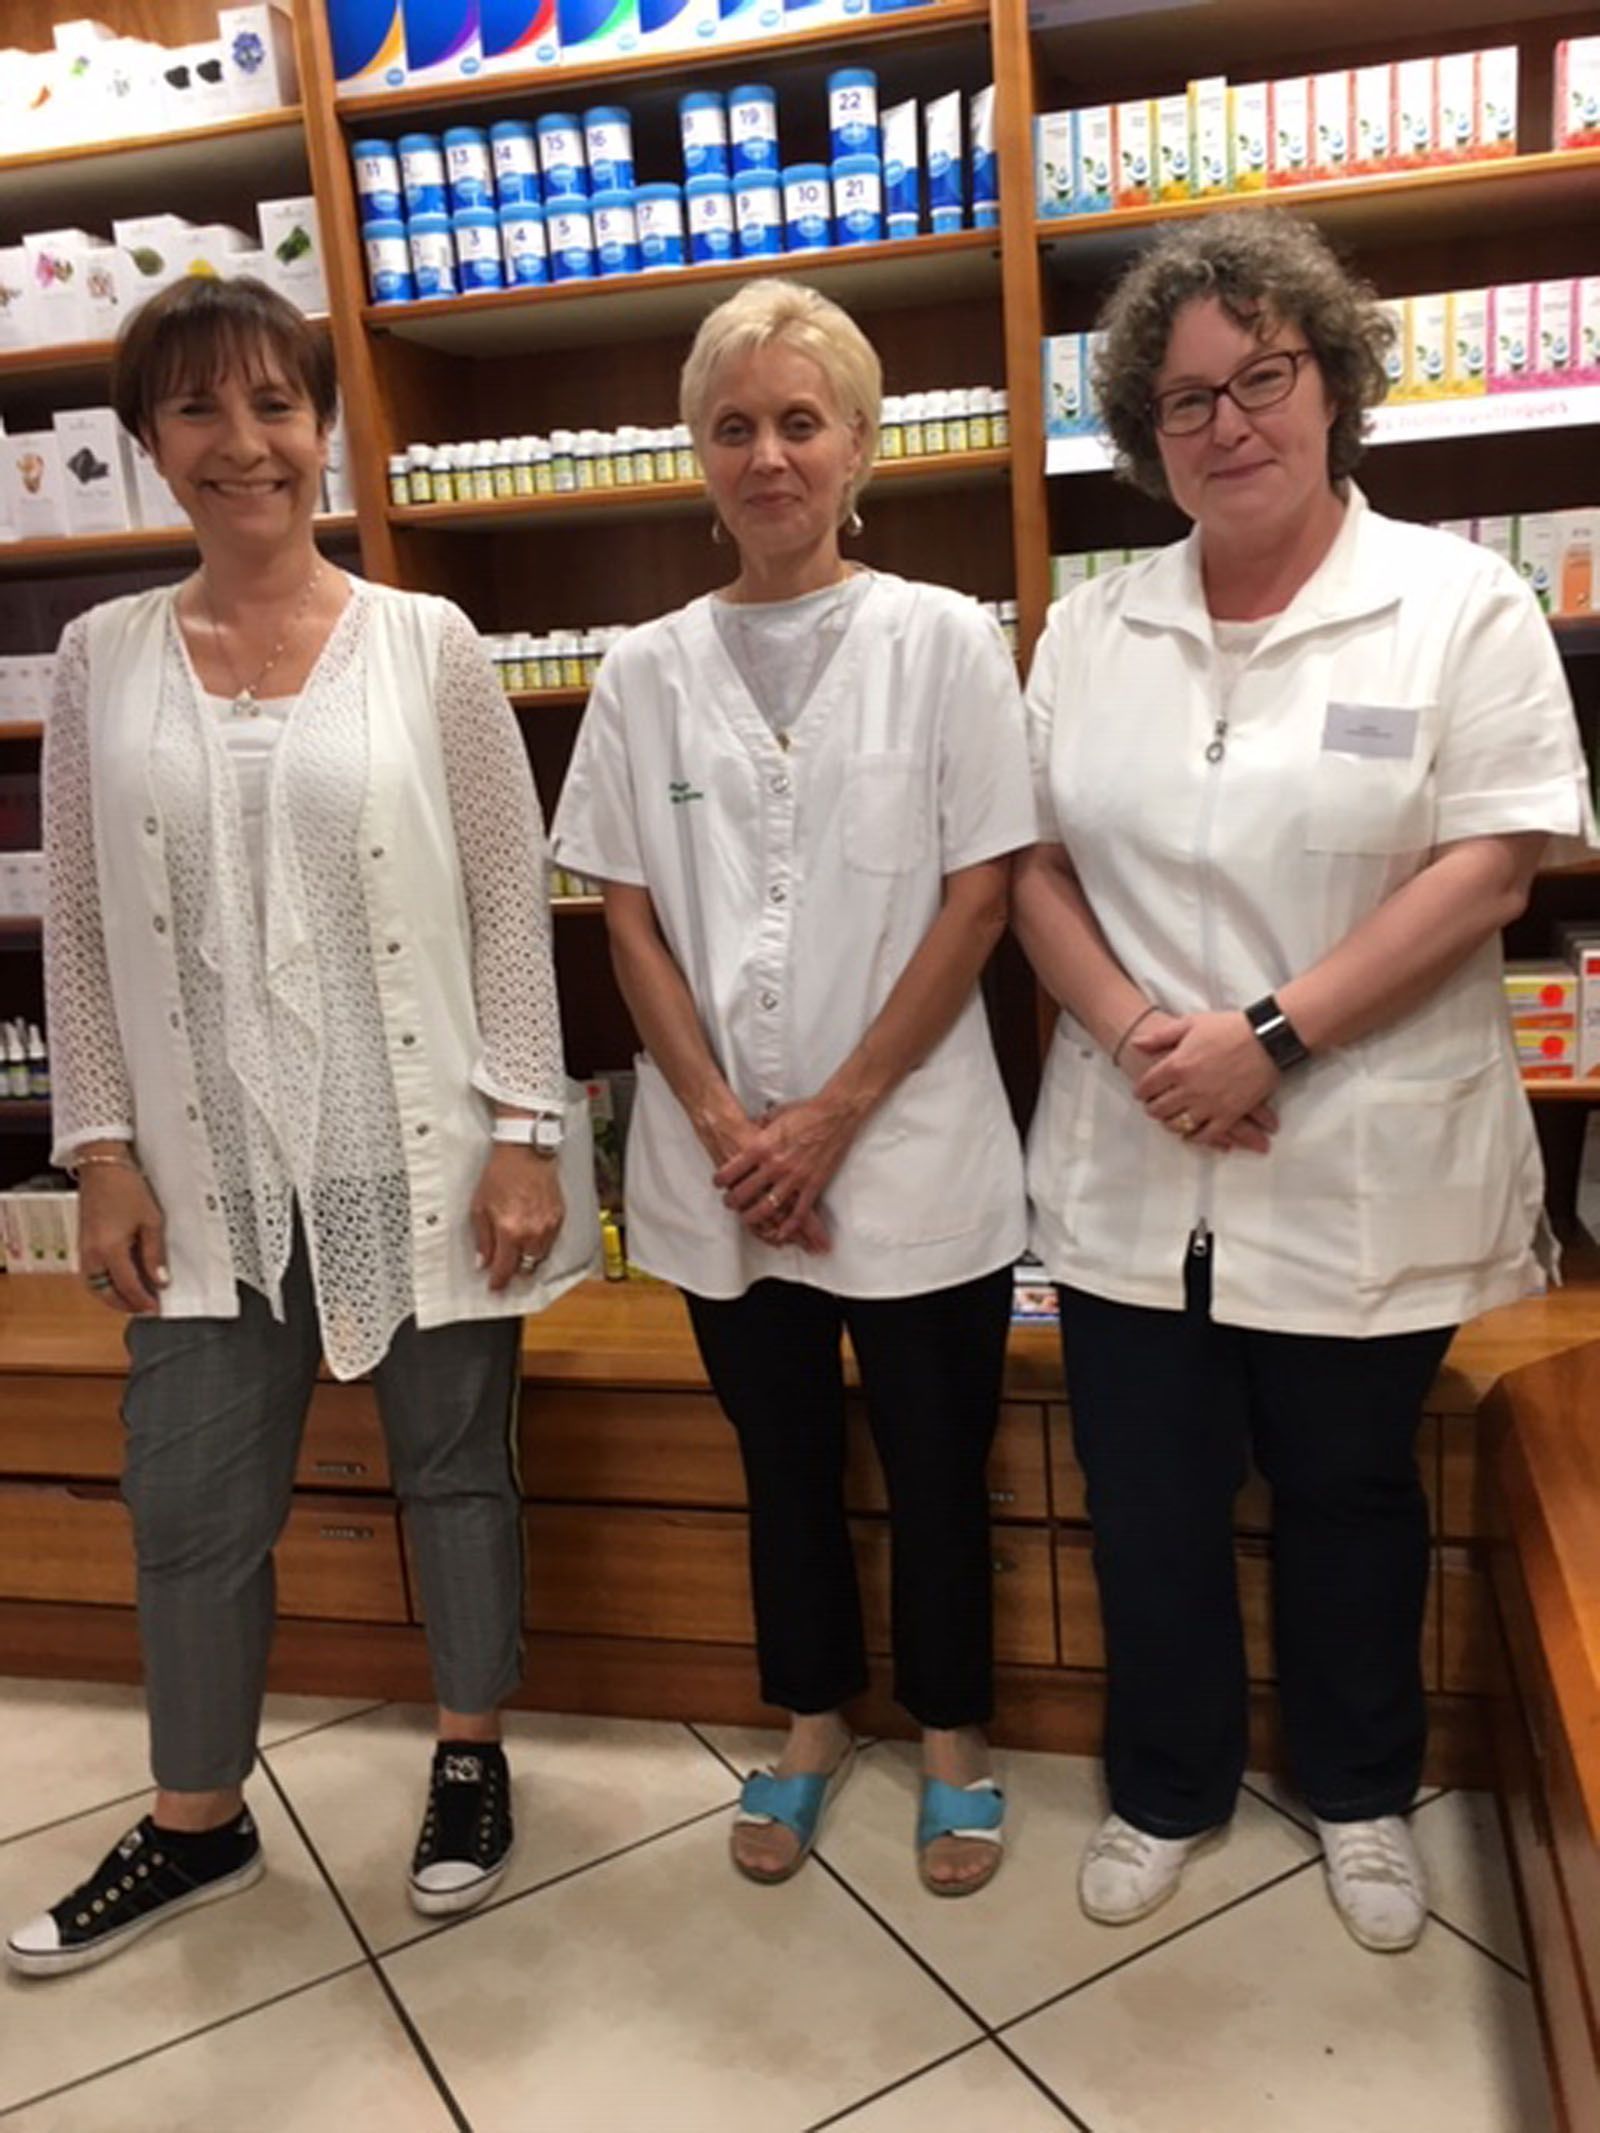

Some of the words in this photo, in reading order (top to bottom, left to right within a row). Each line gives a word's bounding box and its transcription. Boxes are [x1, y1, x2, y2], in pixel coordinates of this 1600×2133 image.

[838, 93, 861, 110] 22
[739, 107, 760, 124] 19
[546, 135, 565, 150] 15
[588, 130, 607, 147] 16
[452, 149, 468, 164] 13
[496, 146, 511, 160] 14
[365, 161, 381, 177] 11
[799, 186, 819, 202] 10
[845, 180, 865, 198] 21
[703, 199, 717, 217] 8
[558, 219, 571, 235] 5
[598, 213, 610, 231] 6
[469, 229, 481, 246] 3
[514, 227, 527, 241] 4
